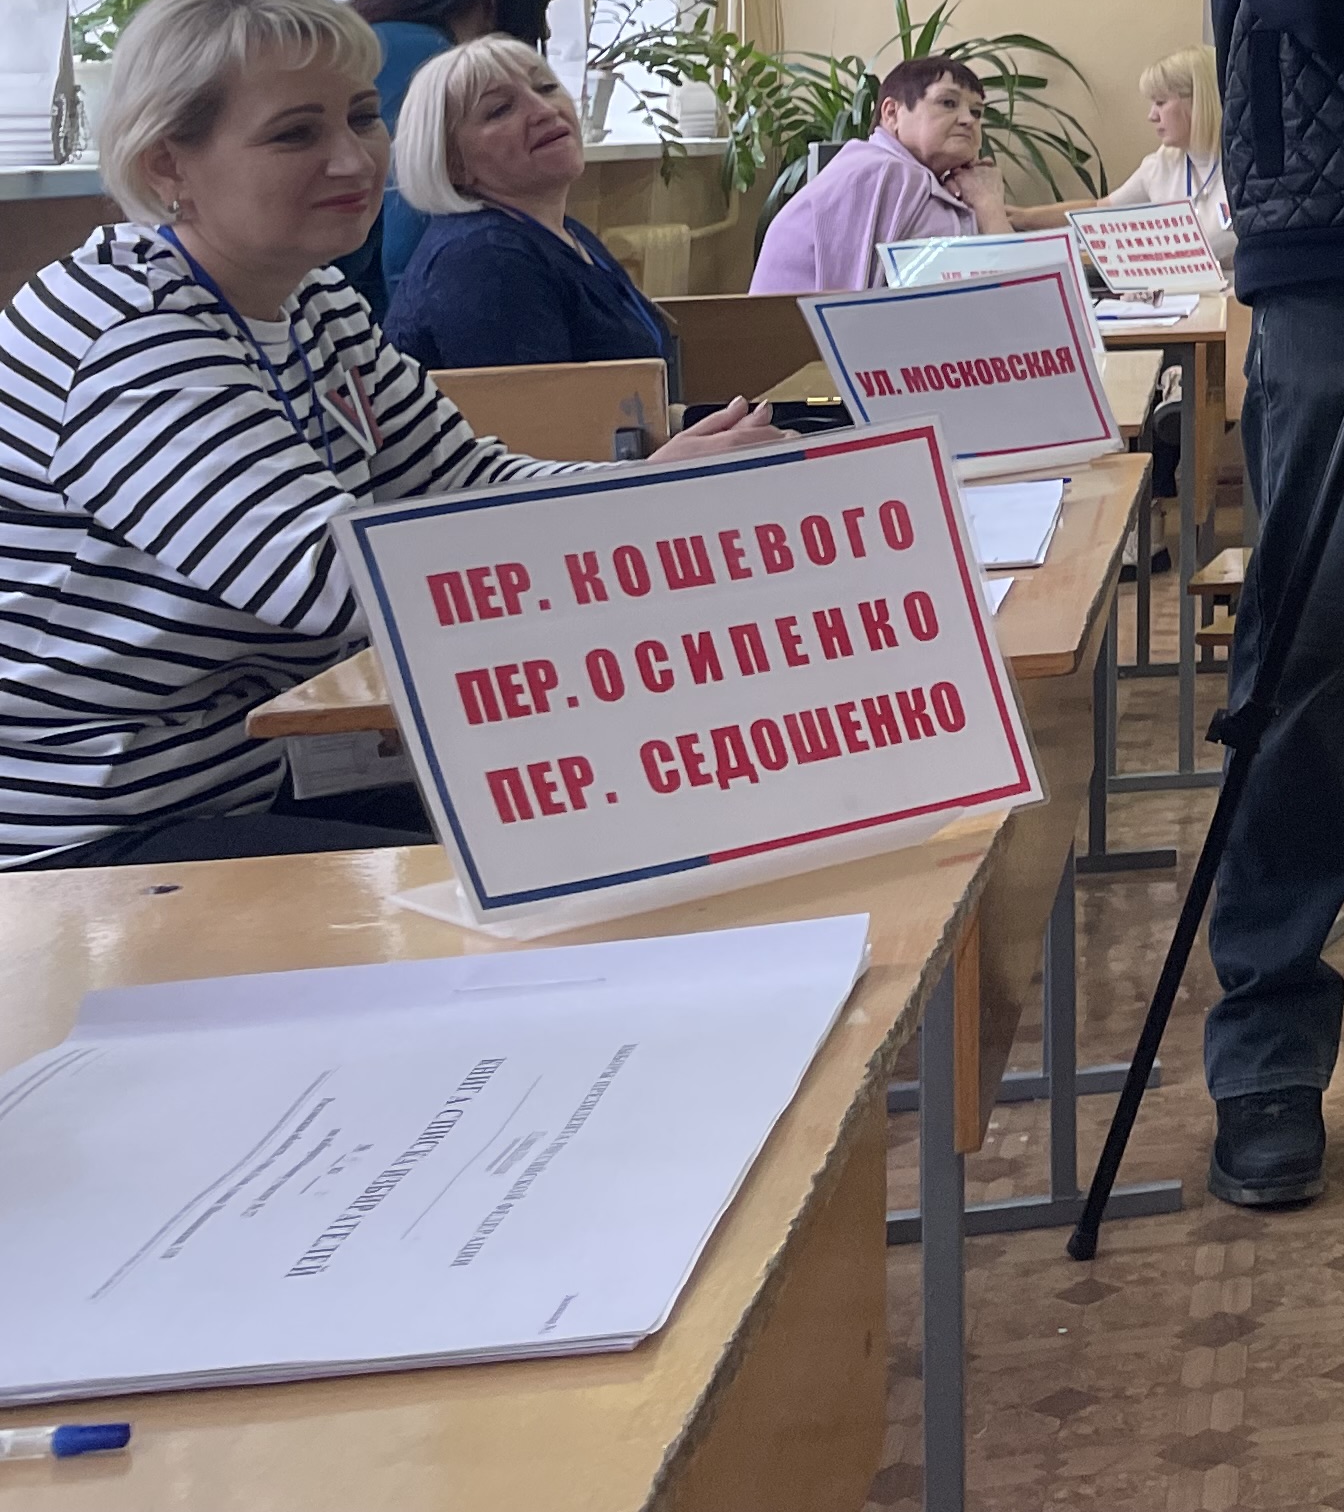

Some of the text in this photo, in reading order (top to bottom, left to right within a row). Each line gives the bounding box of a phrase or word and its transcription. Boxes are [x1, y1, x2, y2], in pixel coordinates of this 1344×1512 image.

[1100, 215, 1193, 235] ДЗЕРЖИНСКОГО
[855, 346, 1076, 398] УЛ. МОСКОВСКАЯ
[426, 499, 915, 627] ПЕР. КОШЕВОГО
[455, 590, 941, 726] ПЕР. ОСИПЕНКО
[486, 680, 968, 825] ПЕР. СЕДОШЕНКО
[445, 1057, 507, 1105] КНИГА
[391, 1109, 463, 1166] СПИСКА
[283, 1168, 413, 1279] ИЗБИРАТЕЛЕЙ
